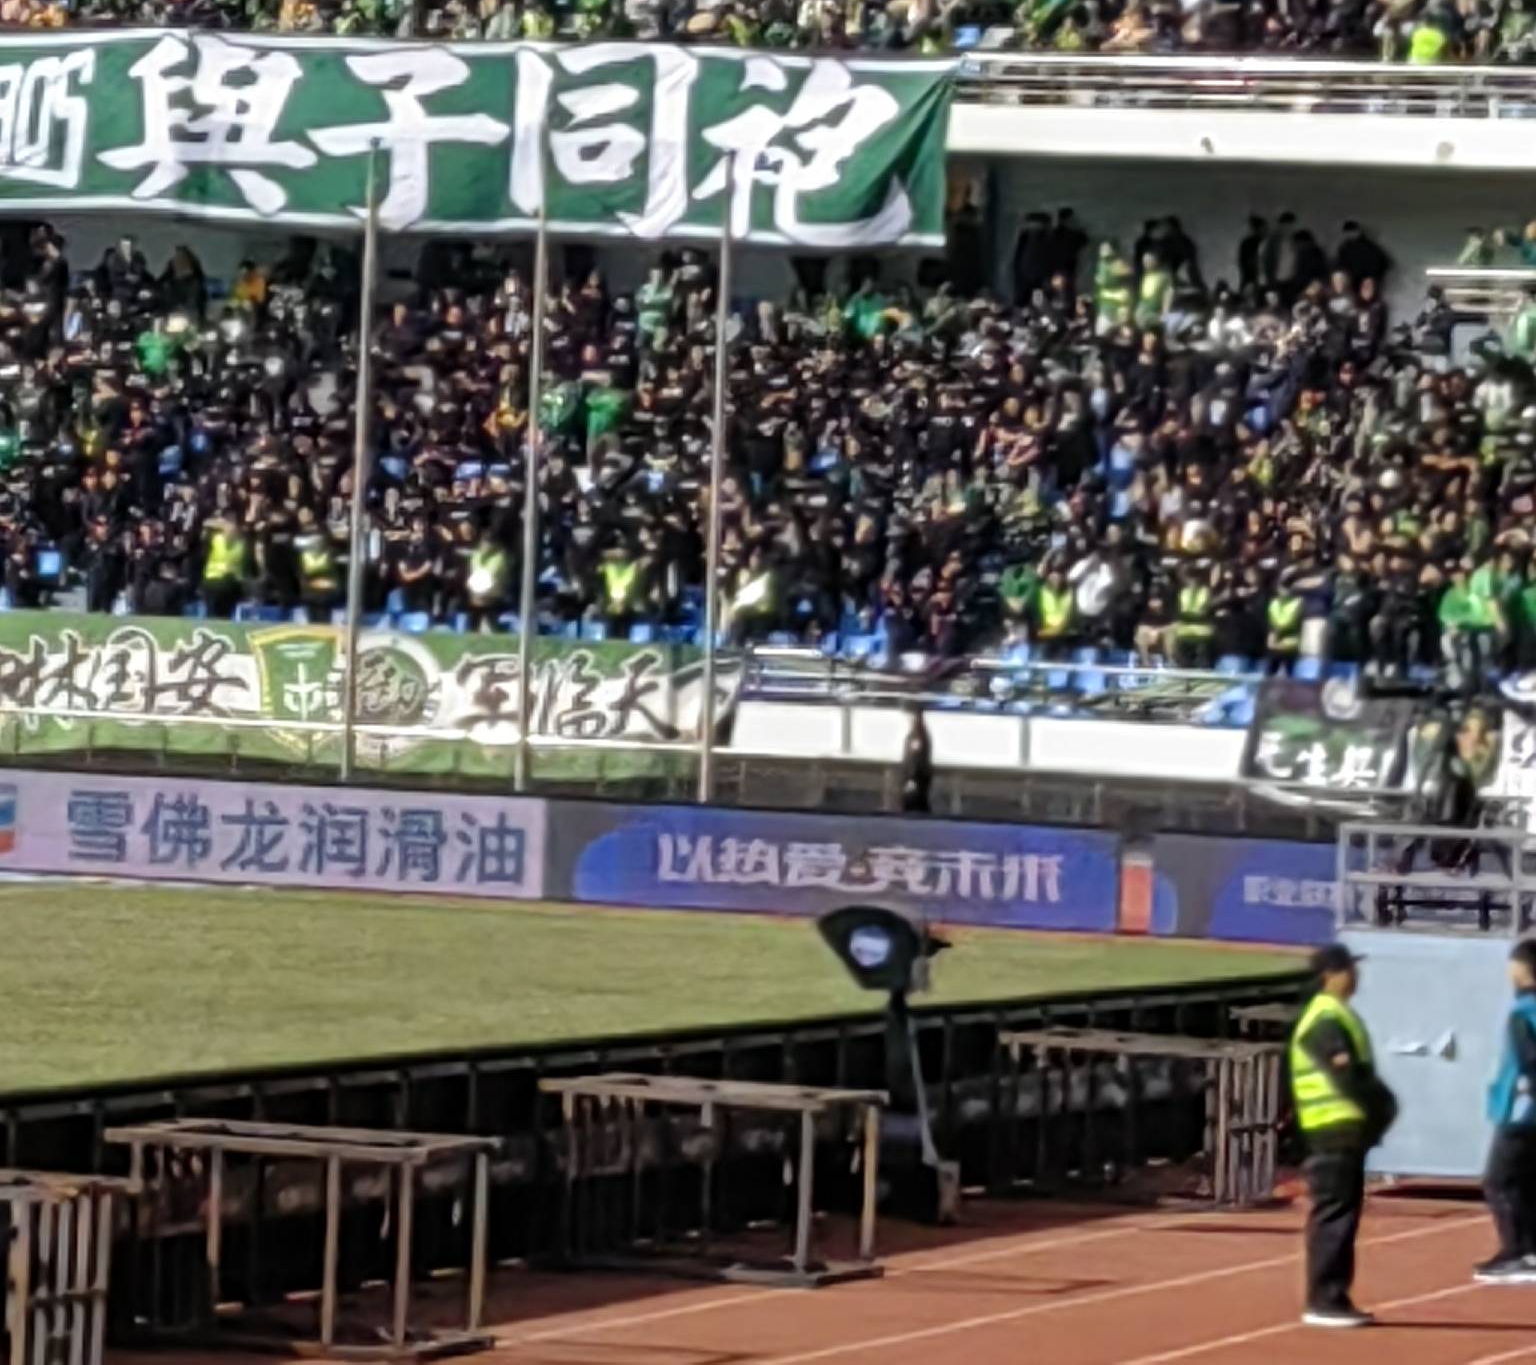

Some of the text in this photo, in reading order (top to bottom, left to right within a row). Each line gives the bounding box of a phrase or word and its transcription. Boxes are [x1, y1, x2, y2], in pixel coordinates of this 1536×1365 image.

[98, 32, 913, 245] 與子同袍
[65, 789, 528, 886] 雪佛龙润滑油
